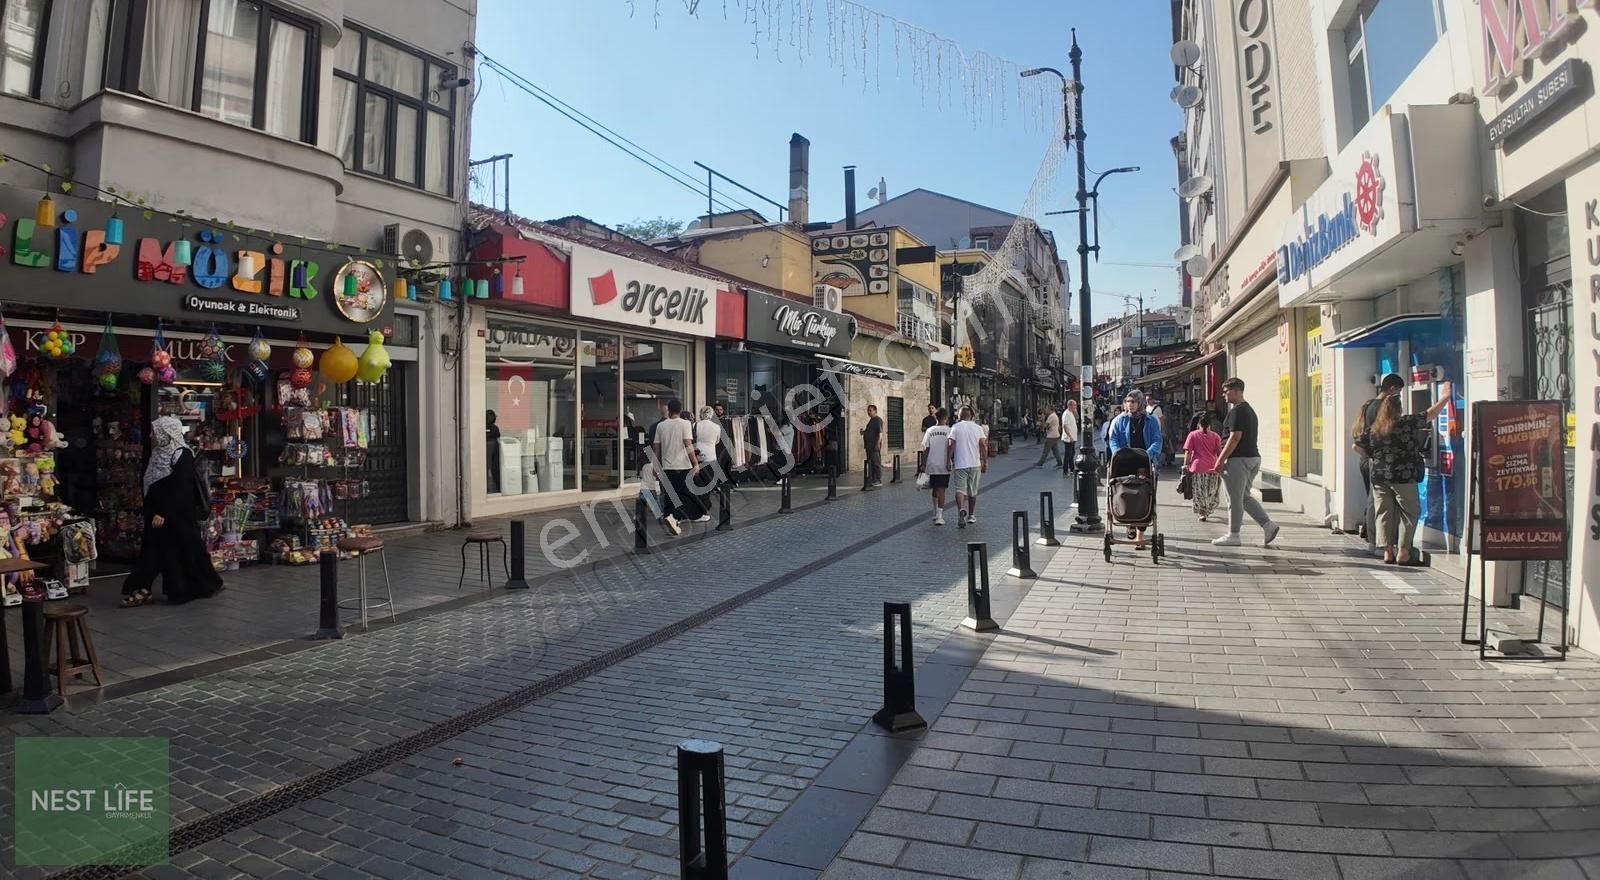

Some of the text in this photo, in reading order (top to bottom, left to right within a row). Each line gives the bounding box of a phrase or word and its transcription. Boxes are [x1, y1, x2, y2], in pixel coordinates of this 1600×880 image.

[1239, 0, 1273, 135] ODE
[0, 208, 120, 274] LİP
[1289, 192, 1357, 281] DenizBank
[190, 297, 298, 319] Oyuncak & Elektronik
[620, 280, 708, 325] arçelik
[24, 330, 236, 362] KP MÜZK
[802, 312, 837, 347] Türkiye
[1486, 531, 1562, 543] ALMAK LAZIM
